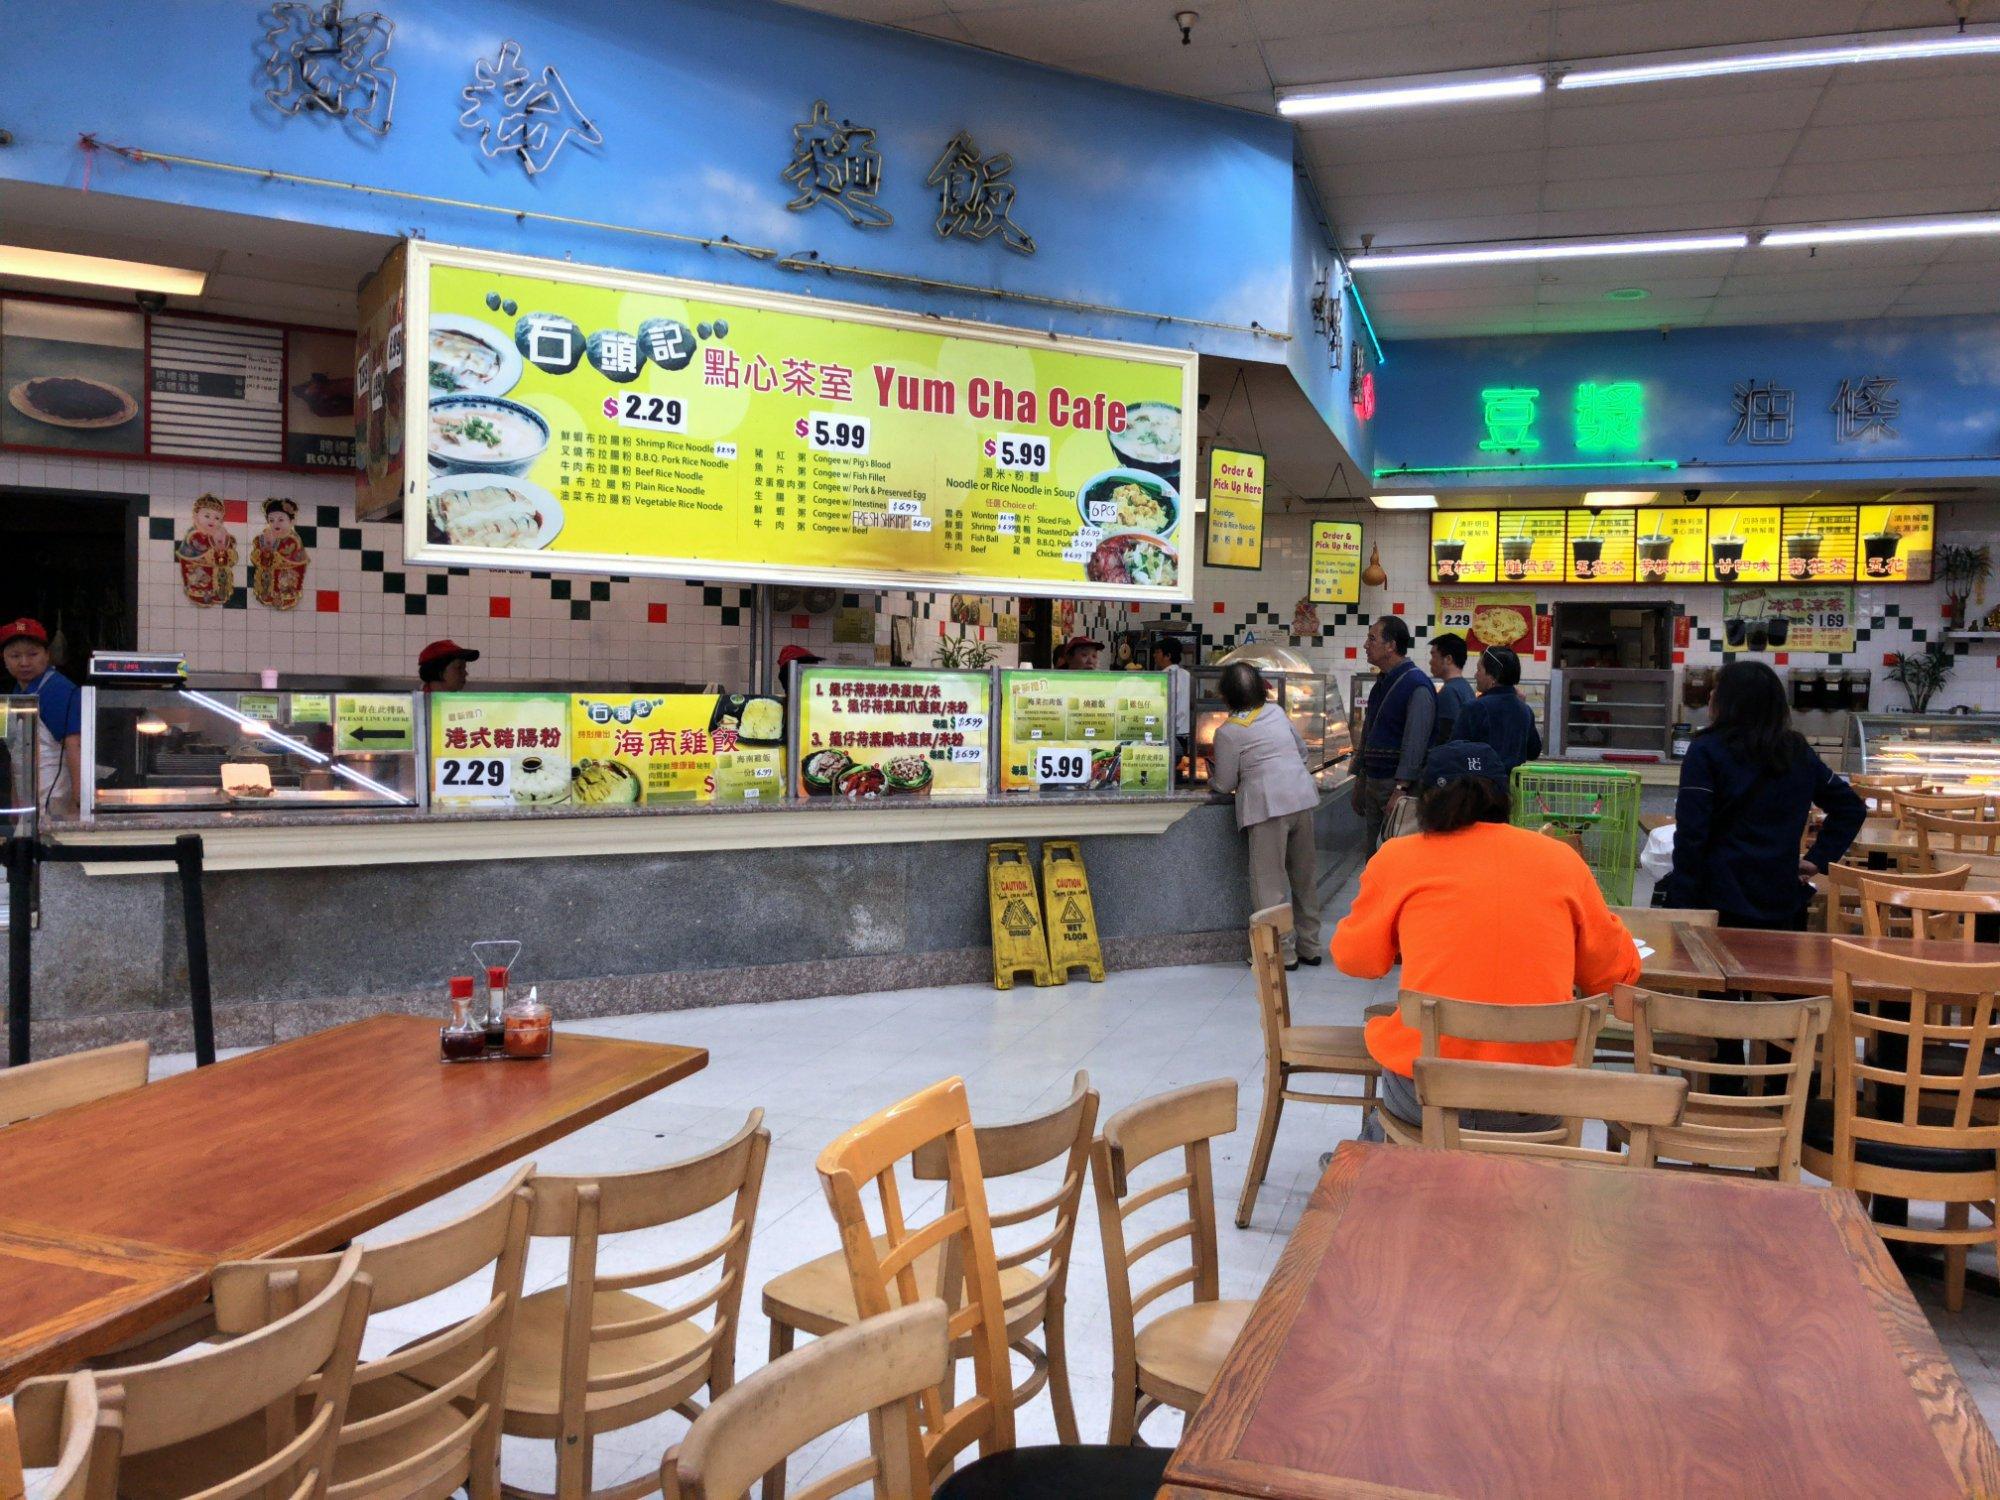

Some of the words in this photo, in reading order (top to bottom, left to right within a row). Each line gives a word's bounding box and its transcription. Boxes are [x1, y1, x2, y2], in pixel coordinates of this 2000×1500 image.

[529, 317, 687, 375] 石頭記
[703, 347, 854, 402] 點心茶室
[872, 364, 956, 416] Yum
[967, 377, 1038, 425] Cha
[1048, 387, 1128, 434] Cafe
[602, 397, 619, 419] $
[625, 394, 682, 425] 2.29
[795, 418, 809, 438] $
[814, 419, 866, 449] 5.99
[635, 437, 666, 449] Shrimp
[667, 440, 684, 449] Rice
[685, 442, 714, 453] Noodle
[984, 438, 997, 458] $
[1001, 441, 1046, 467] 5.99
[635, 452, 660, 463] B.B.Q.
[661, 454, 680, 464] Pork
[682, 456, 699, 466] Rice
[700, 459, 729, 468] Noodle
[813, 454, 840, 465] Congee
[843, 457, 851, 465] w/
[853, 457, 870, 468] Pig's
[871, 460, 891, 469] Blood
[635, 467, 654, 476] Beef
[655, 469, 672, 478] Rice
[674, 471, 703, 480] Noodle
[813, 468, 841, 479] Congee
[843, 471, 851, 479] w/
[853, 472, 867, 480] Fish
[869, 473, 886, 482] Fillet
[1221, 464, 1245, 476] Order
[1246, 467, 1254, 478] &
[635, 481, 655, 491] Plain
[657, 483, 675, 493] Rice
[676, 485, 705, 495] Noodle
[813, 481, 841, 492] Congee
[843, 485, 851, 493] w/
[853, 485, 869, 494] Pork
[871, 486, 876, 494] &
[877, 486, 912, 498] Preserved
[913, 490, 927, 501] Egg
[946, 478, 979, 490] Noodle
[980, 482, 990, 490] or
[991, 482, 1010, 492] Rice
[1011, 483, 1042, 495] Noodle
[1044, 486, 1052, 496] in
[1054, 487, 1076, 499] Soup
[1213, 478, 1229, 490] Pick
[1231, 480, 1242, 494] Up
[1243, 482, 1262, 495] Here
[635, 496, 677, 508] Vegetable
[678, 499, 695, 509] Rice
[813, 495, 840, 506] Congee
[852, 499, 887, 509] Intestines
[1002, 500, 1027, 510] Choice
[813, 510, 840, 520] Congee
[852, 511, 879, 528] FRESH
[880, 513, 910, 530] SHRIMP
[971, 511, 999, 520] Wonton
[1037, 515, 1056, 525] Sliced
[1057, 517, 1071, 526] Fish
[812, 523, 840, 533] Congee
[852, 525, 869, 535] Beef
[971, 522, 996, 532] Shrimp
[1037, 528, 1063, 537] Roasted
[971, 533, 985, 541] Fish
[986, 535, 999, 543] Ball
[1322, 531, 1344, 540] Order
[1345, 532, 1352, 540] &
[971, 544, 986, 553] Beef
[1057, 540, 1072, 548] Pork
[1315, 541, 1329, 549] Pick
[1331, 541, 1341, 551] Up
[1343, 542, 1360, 551] Here
[1036, 550, 1062, 559] Chicken
[1445, 614, 1470, 626] 2.29
[1819, 613, 1844, 628] 1.69
[1243, 630, 1255, 644] A
[592, 701, 649, 722] 石頭記
[444, 725, 562, 749] 港式豬腸粉
[613, 727, 740, 757] 海南雞飯
[442, 759, 505, 787] 2.29
[1041, 755, 1083, 779] 5.99
[703, 775, 715, 794] $
[1001, 880, 1028, 891] CAUTION
[1056, 878, 1082, 889] CAUTION
[1066, 924, 1082, 932] WET
[1063, 932, 1088, 941] FLOOR
